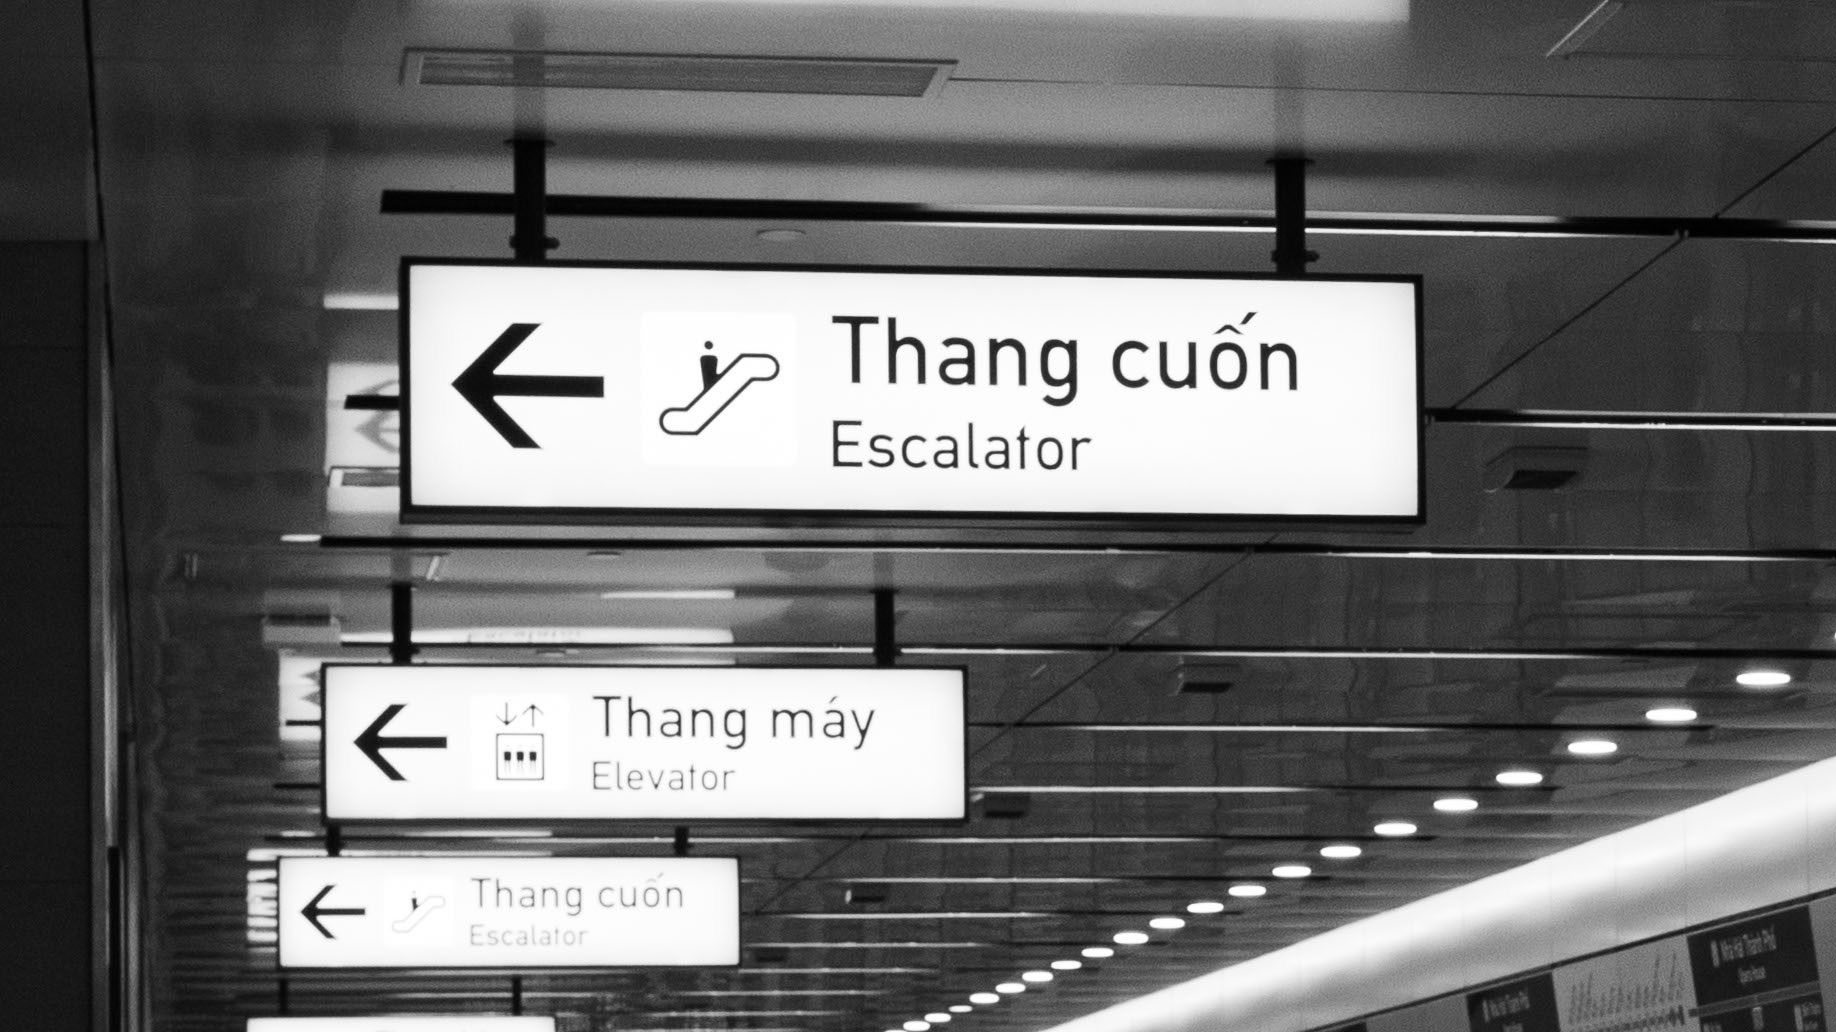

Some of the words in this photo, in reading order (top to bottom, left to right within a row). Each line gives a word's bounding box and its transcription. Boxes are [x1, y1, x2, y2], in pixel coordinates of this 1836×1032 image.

[831, 315, 1078, 408] Thang
[1111, 311, 1298, 391] cuốn
[832, 419, 1092, 471] Escalator
[592, 695, 747, 751] Thang
[771, 695, 875, 751] máy
[592, 760, 734, 791] Elevator
[471, 876, 582, 916] Thang
[598, 872, 683, 908] cuốn
[469, 924, 588, 947] Escalator
